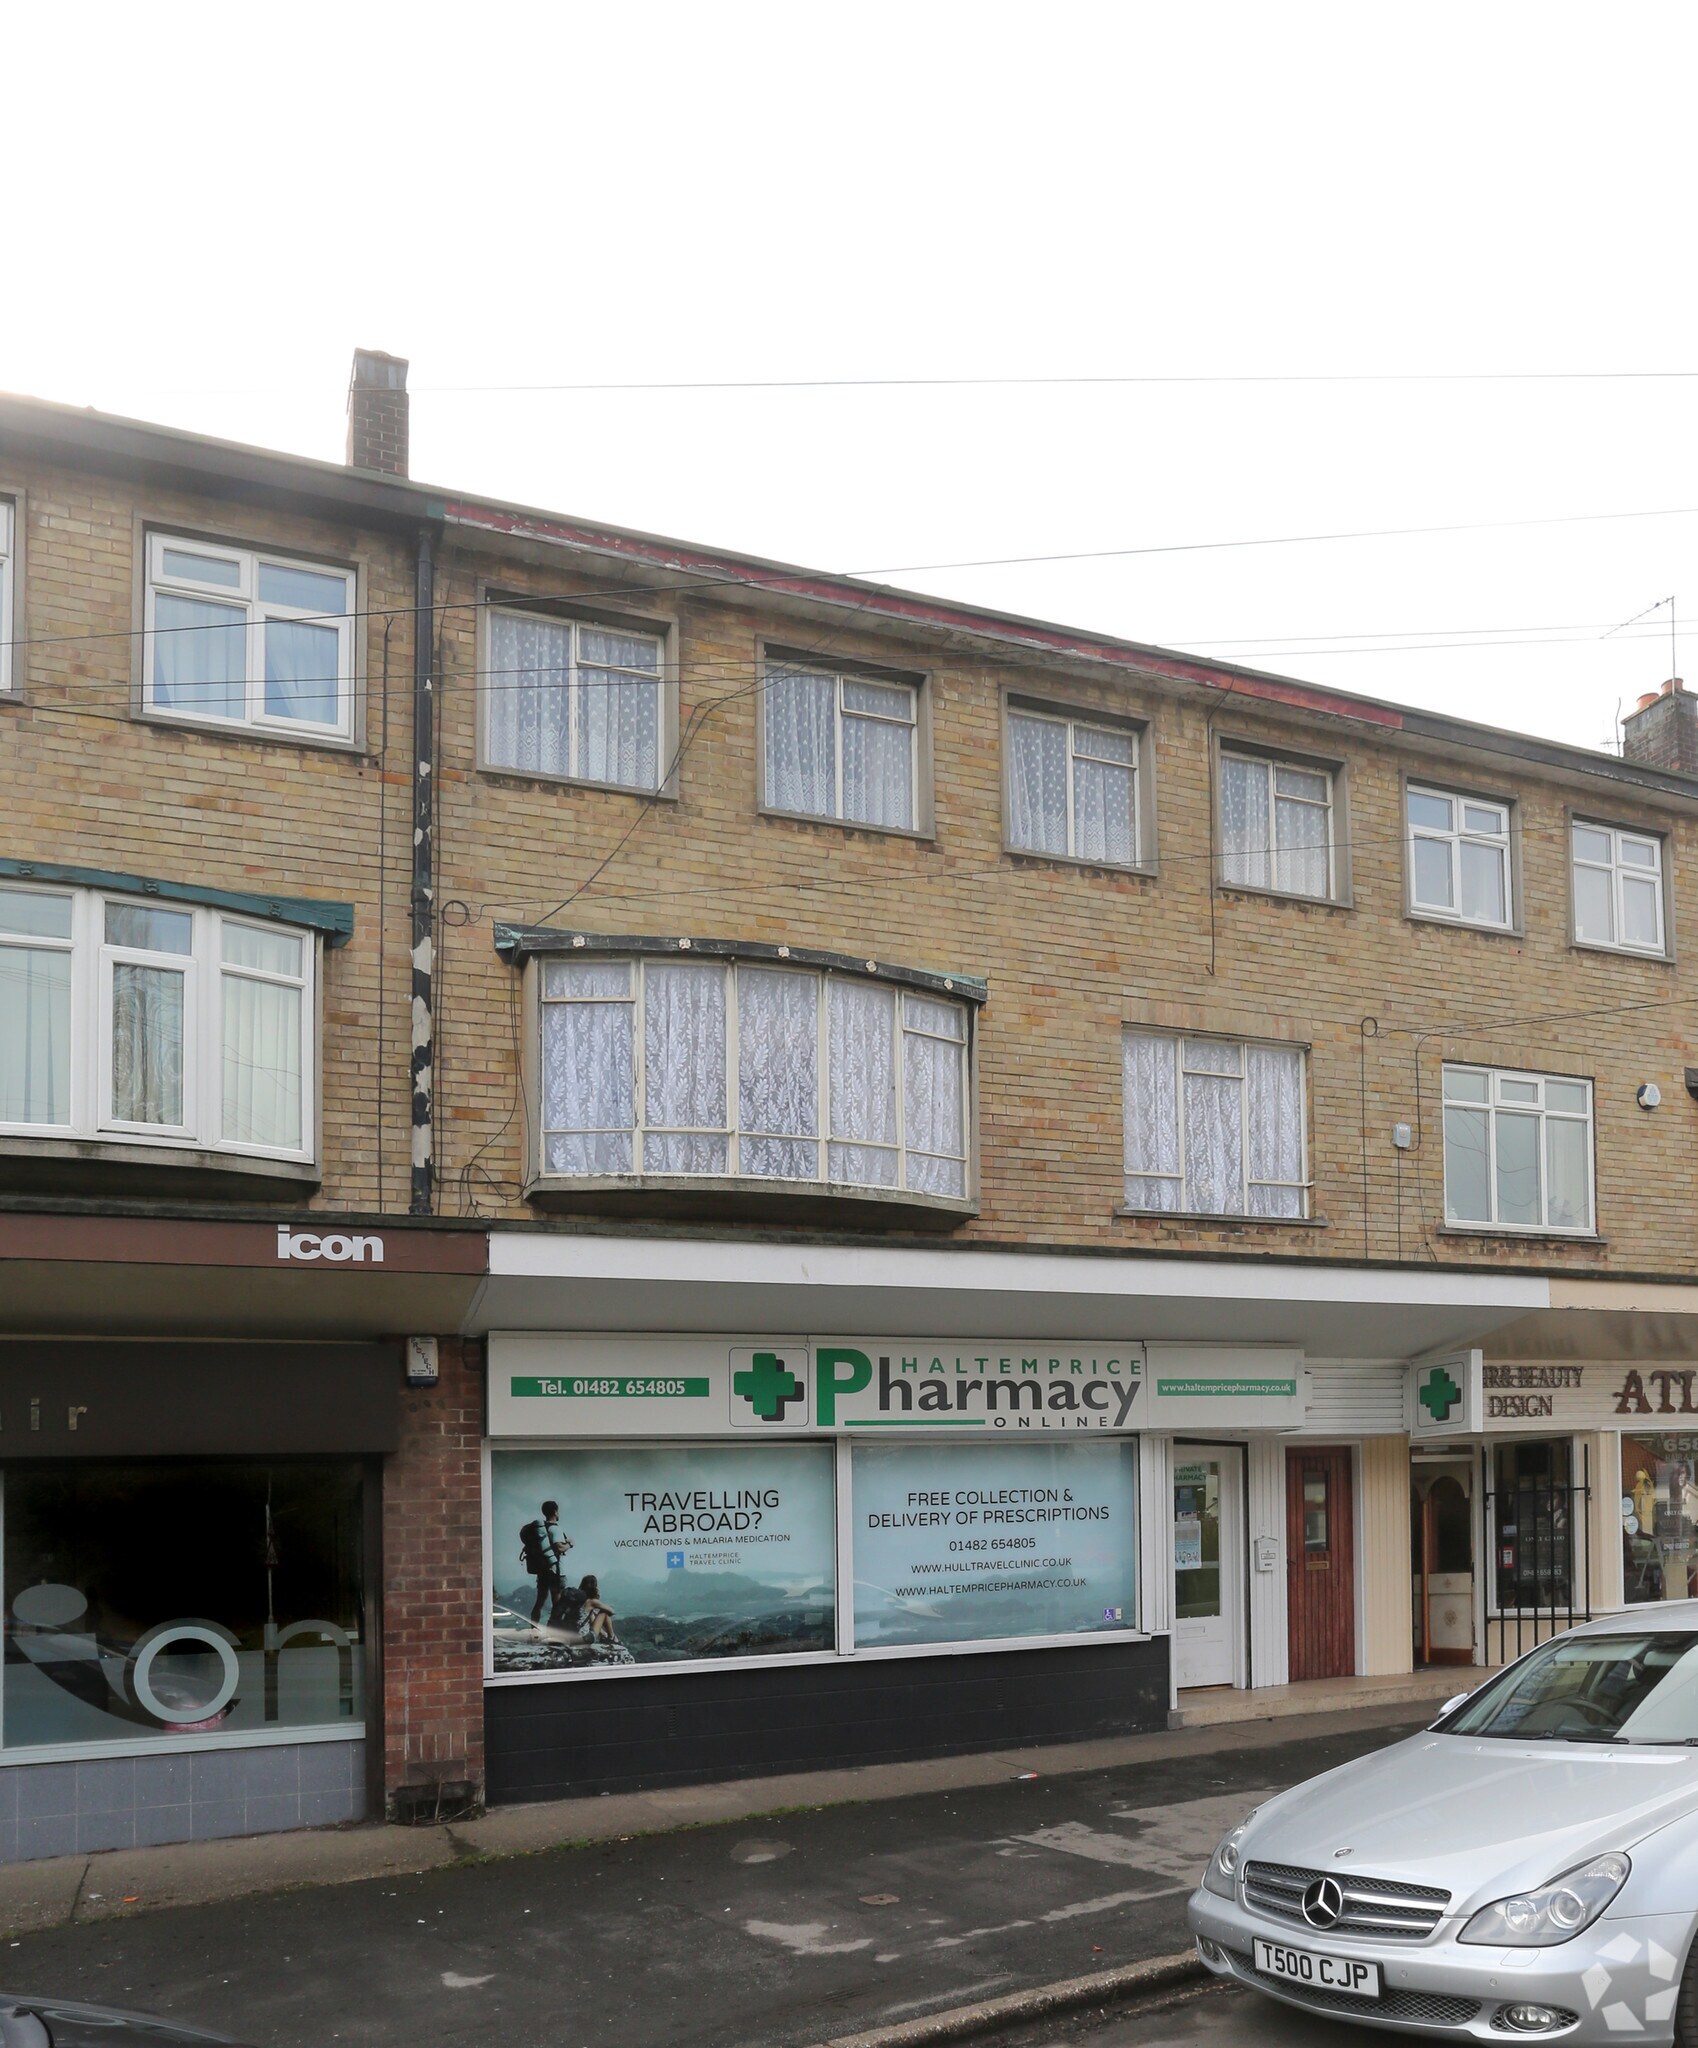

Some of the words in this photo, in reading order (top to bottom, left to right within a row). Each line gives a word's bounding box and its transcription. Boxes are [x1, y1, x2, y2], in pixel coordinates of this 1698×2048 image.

[277, 1224, 384, 1262] icon
[901, 1357, 1142, 1375] HALTEMPRICE
[1517, 1366, 1584, 1388] BEAUTY
[537, 1380, 567, 1395] Tel.
[573, 1380, 620, 1395] 01482
[625, 1380, 686, 1395] 654805
[816, 1348, 1141, 1427] Pharmacy
[1161, 1382, 1292, 1395] www.haltempricepharmacy.co.uk
[1488, 1394, 1553, 1417] DESIGN
[993, 1416, 1109, 1428] ONLINE
[624, 1489, 779, 1511] TRAVELLING
[907, 1491, 950, 1507] FREE
[955, 1489, 1058, 1505] COLLECTION
[1063, 1488, 1074, 1502] &
[643, 1511, 763, 1533] ABROAD?
[868, 1511, 951, 1528] DELIVERY
[955, 1510, 978, 1525] OF
[983, 1506, 1110, 1524] PRESCRIPTIONS
[614, 1538, 682, 1548] VACCINATIONS
[684, 1537, 691, 1546] &
[693, 1536, 733, 1545] MALARIA
[735, 1534, 791, 1543] MEDICATION
[949, 1540, 987, 1552] 01482
[991, 1537, 1036, 1550] 654805
[689, 1552, 739, 1560] HALTEMPRICE
[911, 1557, 1072, 1574] WWW.HULLTRAVELCLINIC.CO.UK
[895, 1578, 1086, 1597] WWW.HALTEMPRICEPHARMACY.CO.UK
[1262, 1944, 1313, 1980] T500
[1319, 1959, 1368, 1989] CJP
